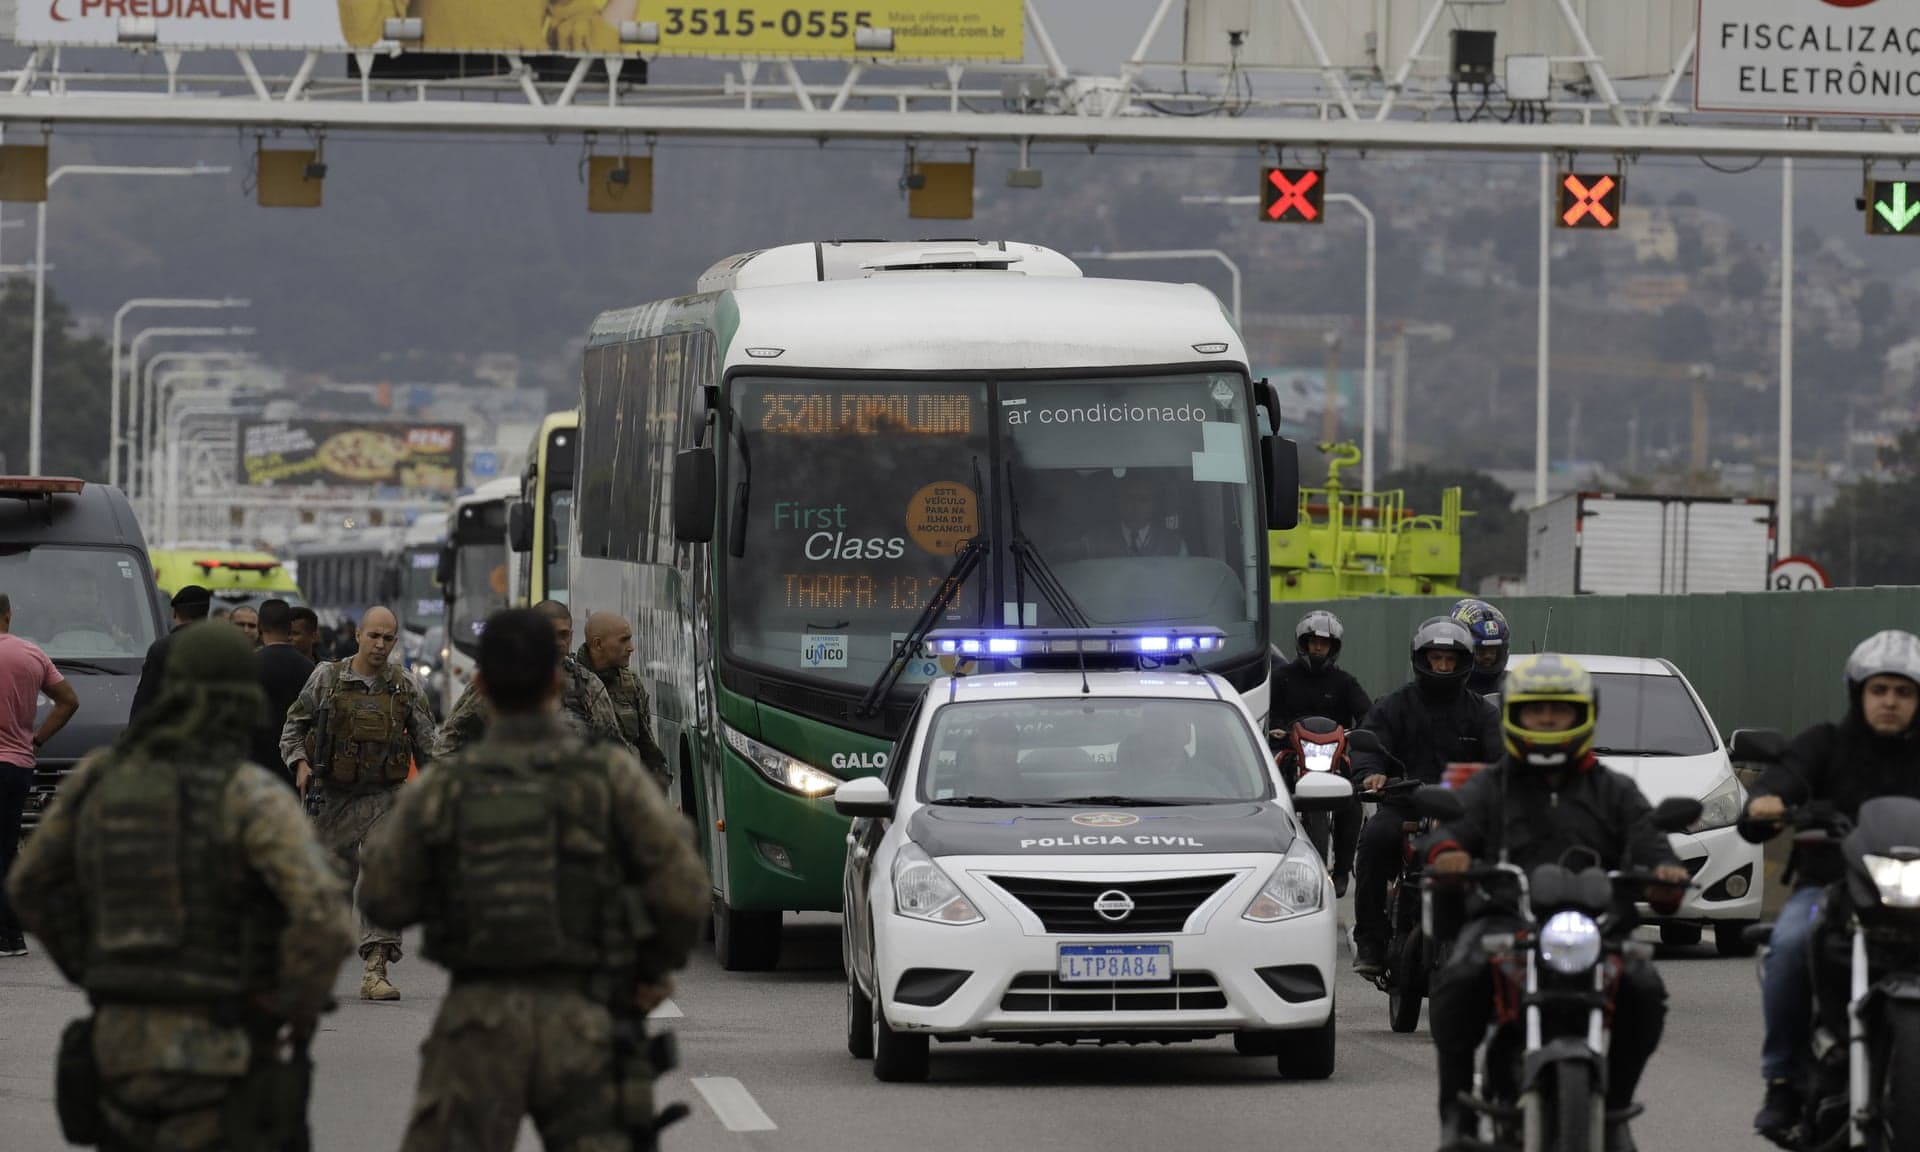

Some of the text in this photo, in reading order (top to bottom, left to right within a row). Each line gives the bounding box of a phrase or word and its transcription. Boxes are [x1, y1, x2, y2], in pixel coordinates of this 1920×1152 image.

[664, 9, 873, 39] 3515-0555
[891, 25, 1005, 39] redialnet.com.br
[1721, 22, 1920, 56] FISCALIZAÇ
[1739, 61, 1920, 96] ELETRÔNIC
[1008, 402, 1207, 425] ar condicionado
[924, 496, 967, 505] VEÍCULO
[934, 487, 957, 496] ESTE
[774, 501, 848, 530] First
[926, 506, 966, 514] PARA NA
[927, 515, 964, 523] ILHA DE
[804, 531, 905, 561] Class
[1776, 573, 1818, 591] 80
[805, 643, 844, 663] ÚNICO
[831, 751, 888, 769] GALO
[1020, 834, 1204, 849] POLÍCIA CIVIL
[1069, 956, 1158, 978] LTP8A84
